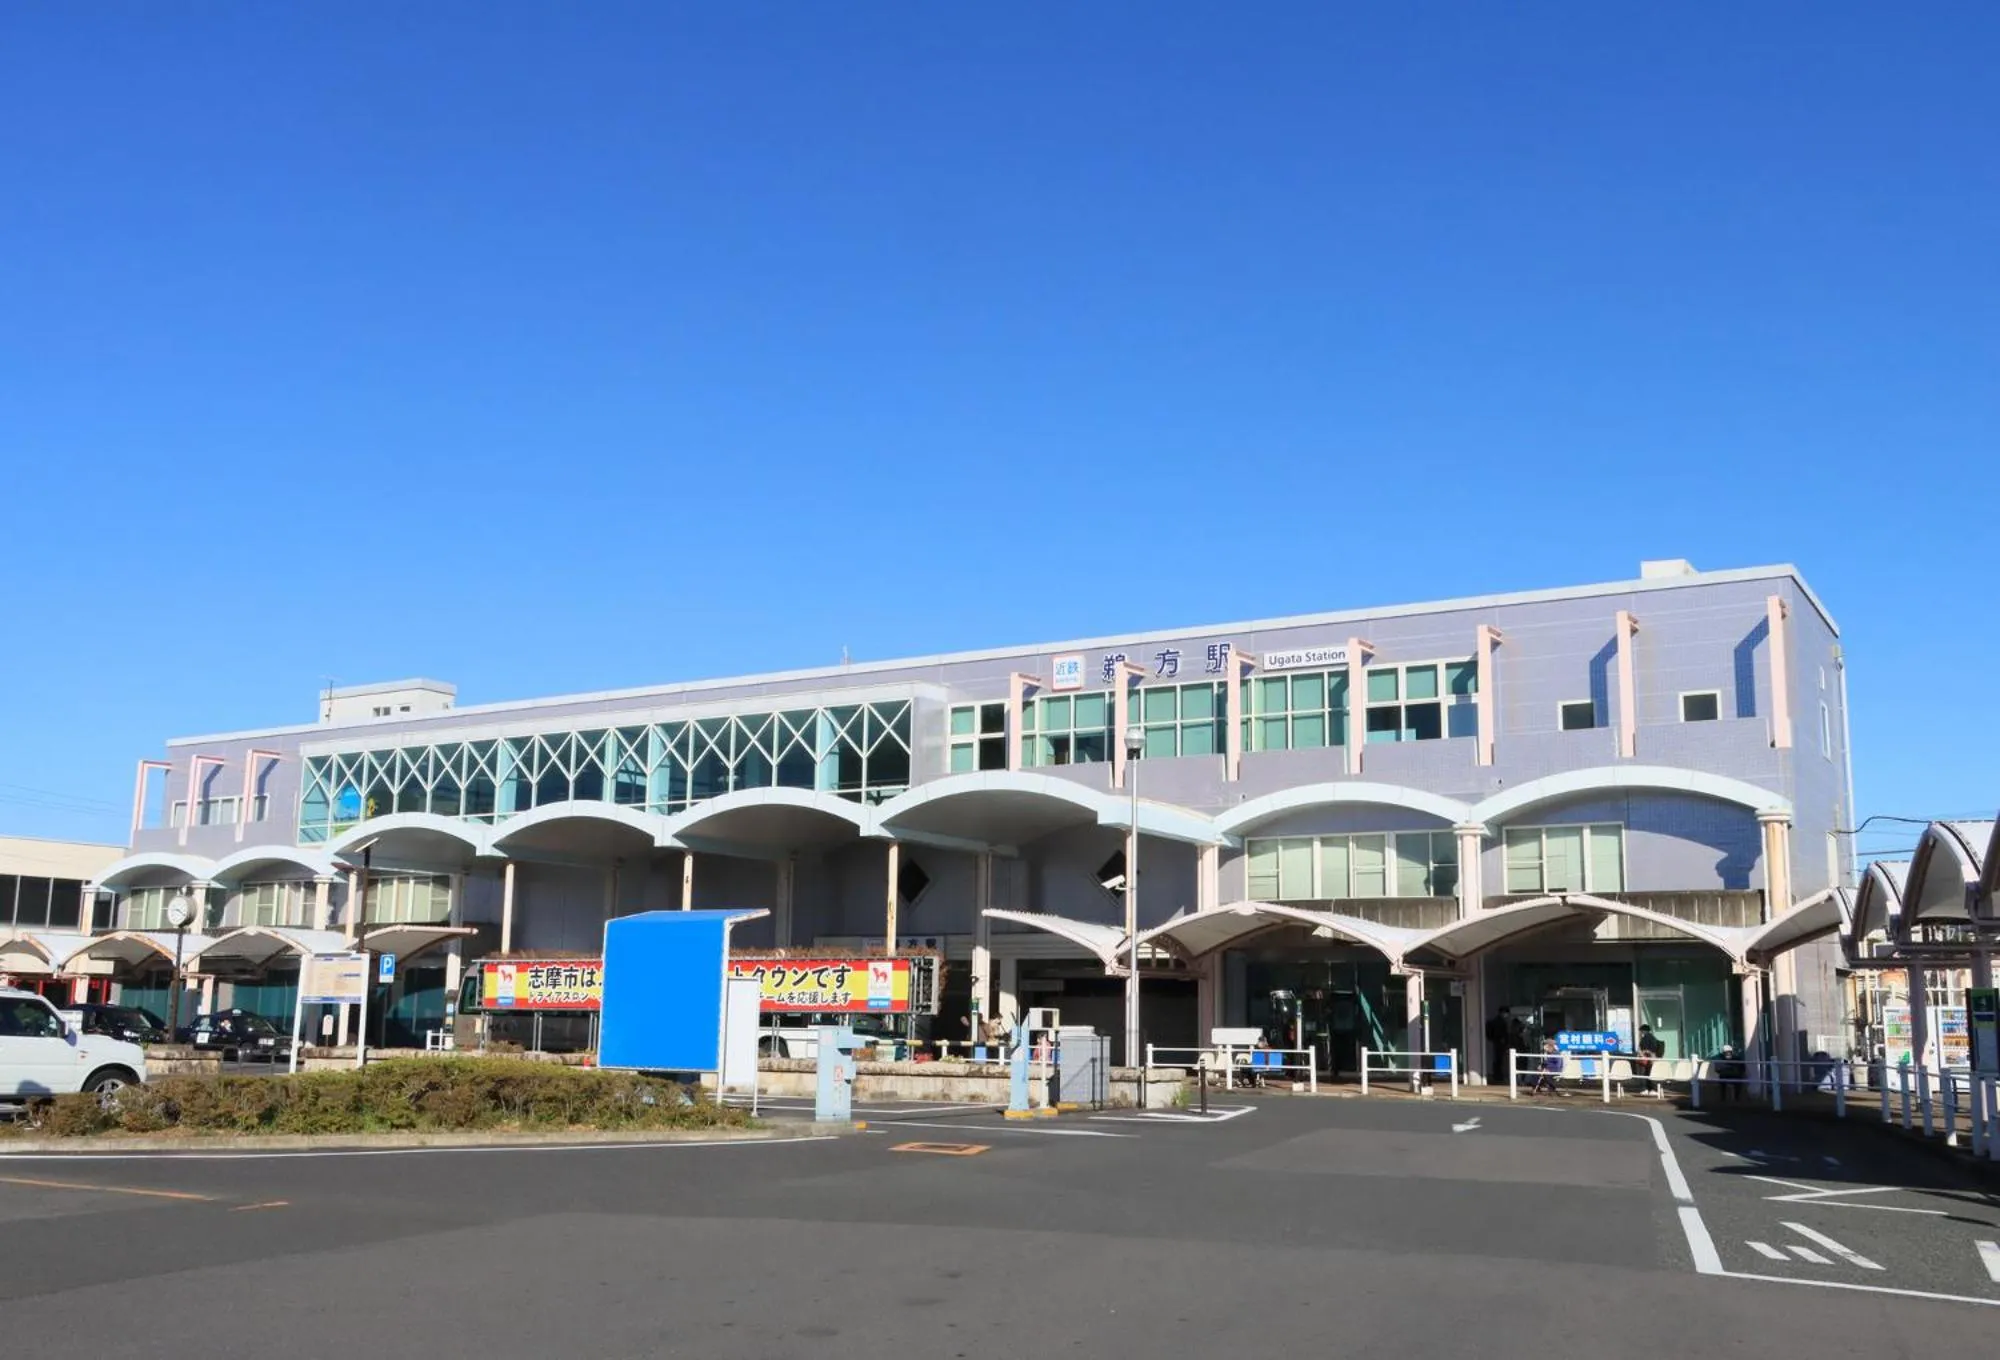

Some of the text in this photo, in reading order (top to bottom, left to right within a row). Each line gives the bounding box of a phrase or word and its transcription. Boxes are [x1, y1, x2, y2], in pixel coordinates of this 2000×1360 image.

[1269, 650, 1347, 668] Ugata Station
[383, 957, 392, 973] P
[528, 966, 602, 988] 志摩市は
